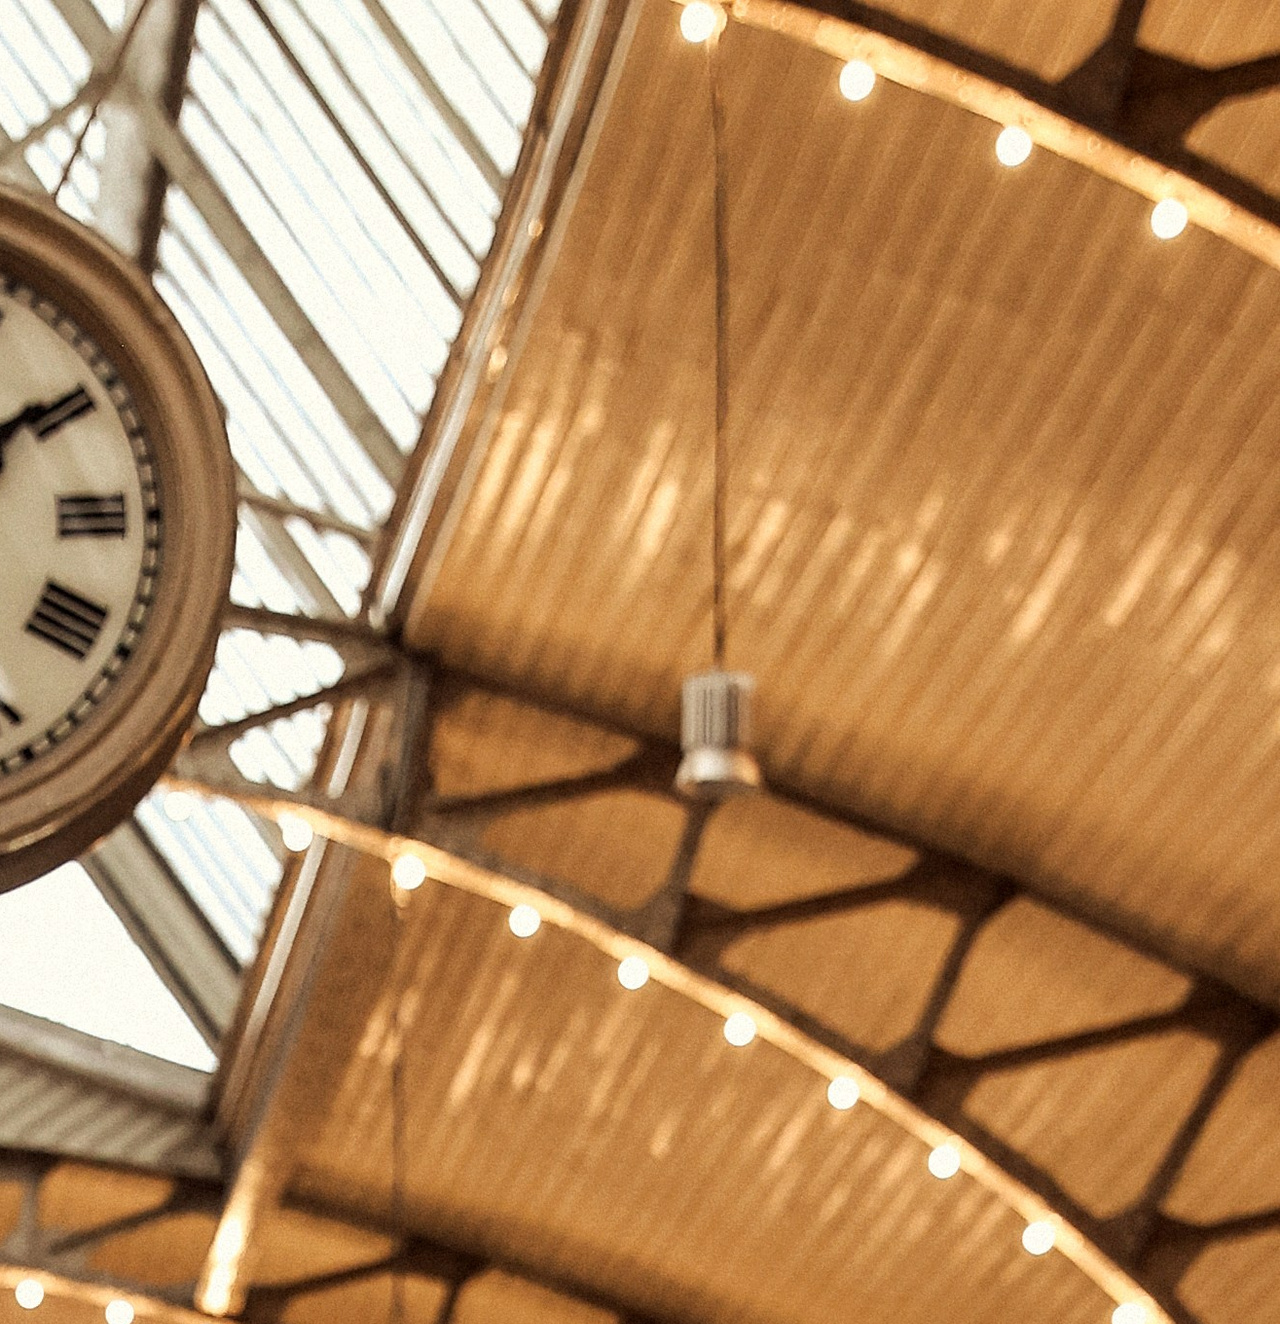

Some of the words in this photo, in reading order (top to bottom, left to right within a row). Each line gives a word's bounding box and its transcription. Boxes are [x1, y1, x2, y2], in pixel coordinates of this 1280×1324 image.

[32, 384, 98, 441] II
[56, 493, 126, 540] III
[25, 576, 109, 662] IIII
